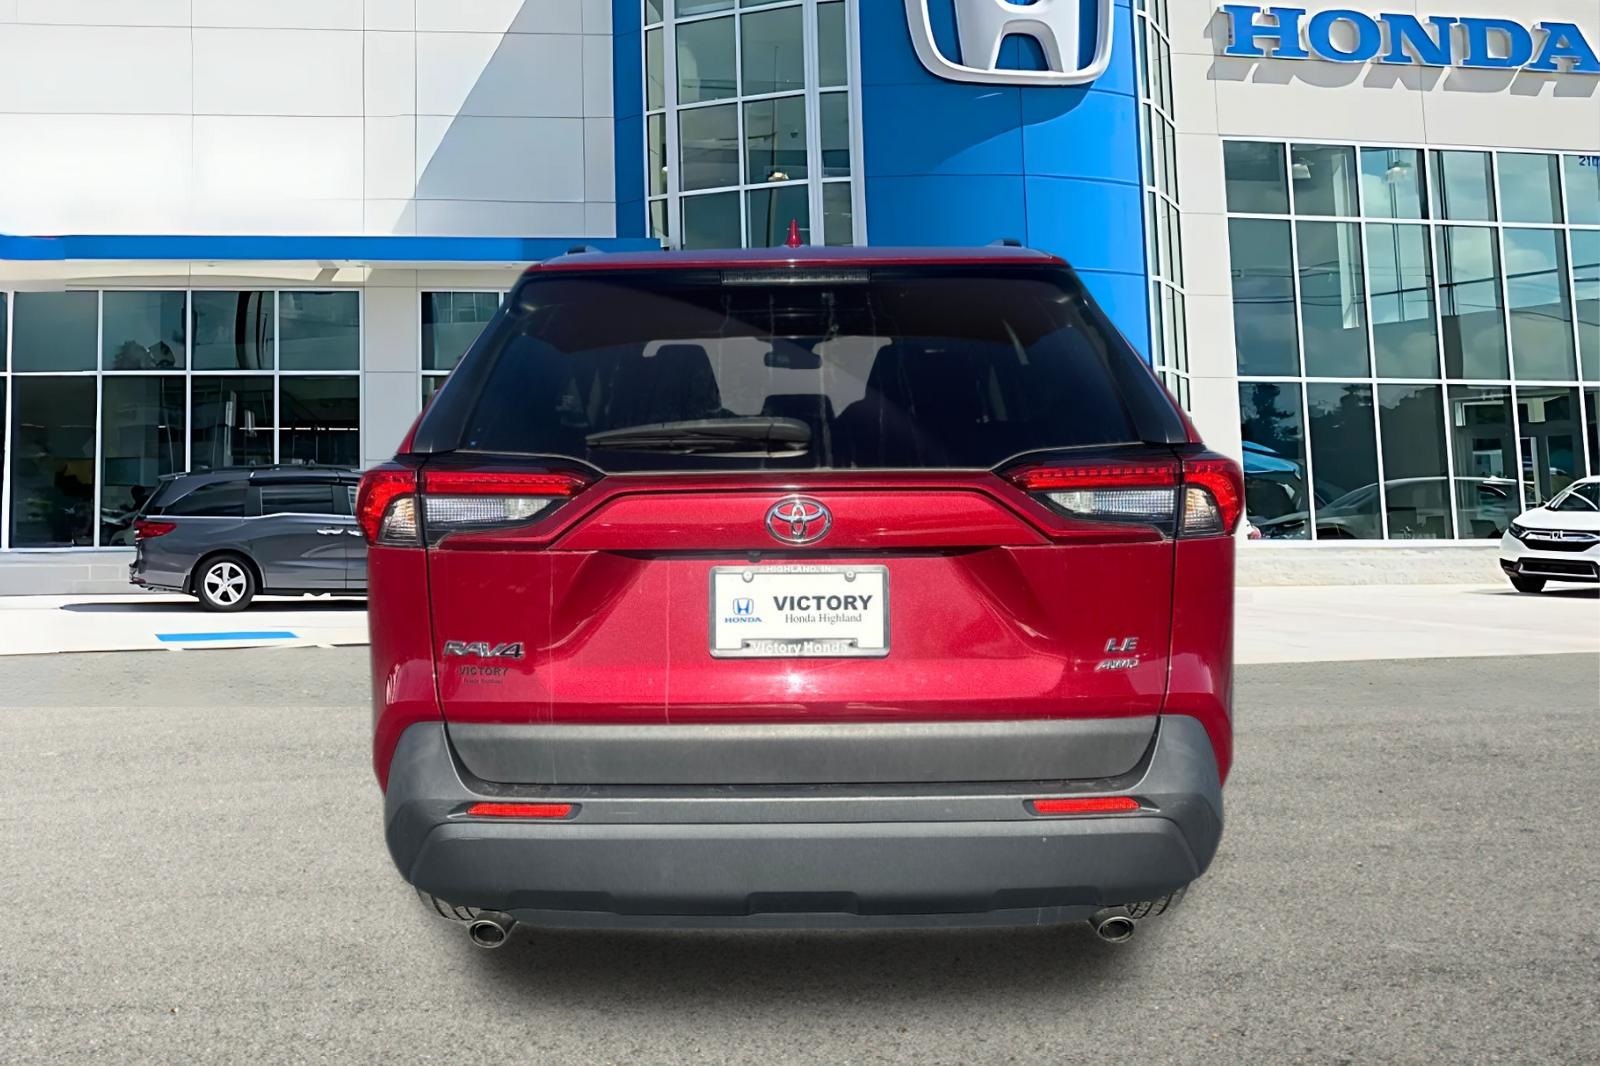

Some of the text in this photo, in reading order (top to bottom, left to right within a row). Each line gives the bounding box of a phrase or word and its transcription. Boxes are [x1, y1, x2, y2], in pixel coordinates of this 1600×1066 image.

[1223, 4, 1600, 73] HONDA
[773, 595, 872, 611] VICTORY
[724, 616, 762, 624] HONDA
[785, 613, 862, 625] Honda Highland
[443, 640, 525, 659] RAV4
[753, 641, 848, 656] Victory Honda
[1104, 637, 1139, 653] LE
[460, 665, 509, 676] VICTORY
[1094, 657, 1140, 672] AWD
